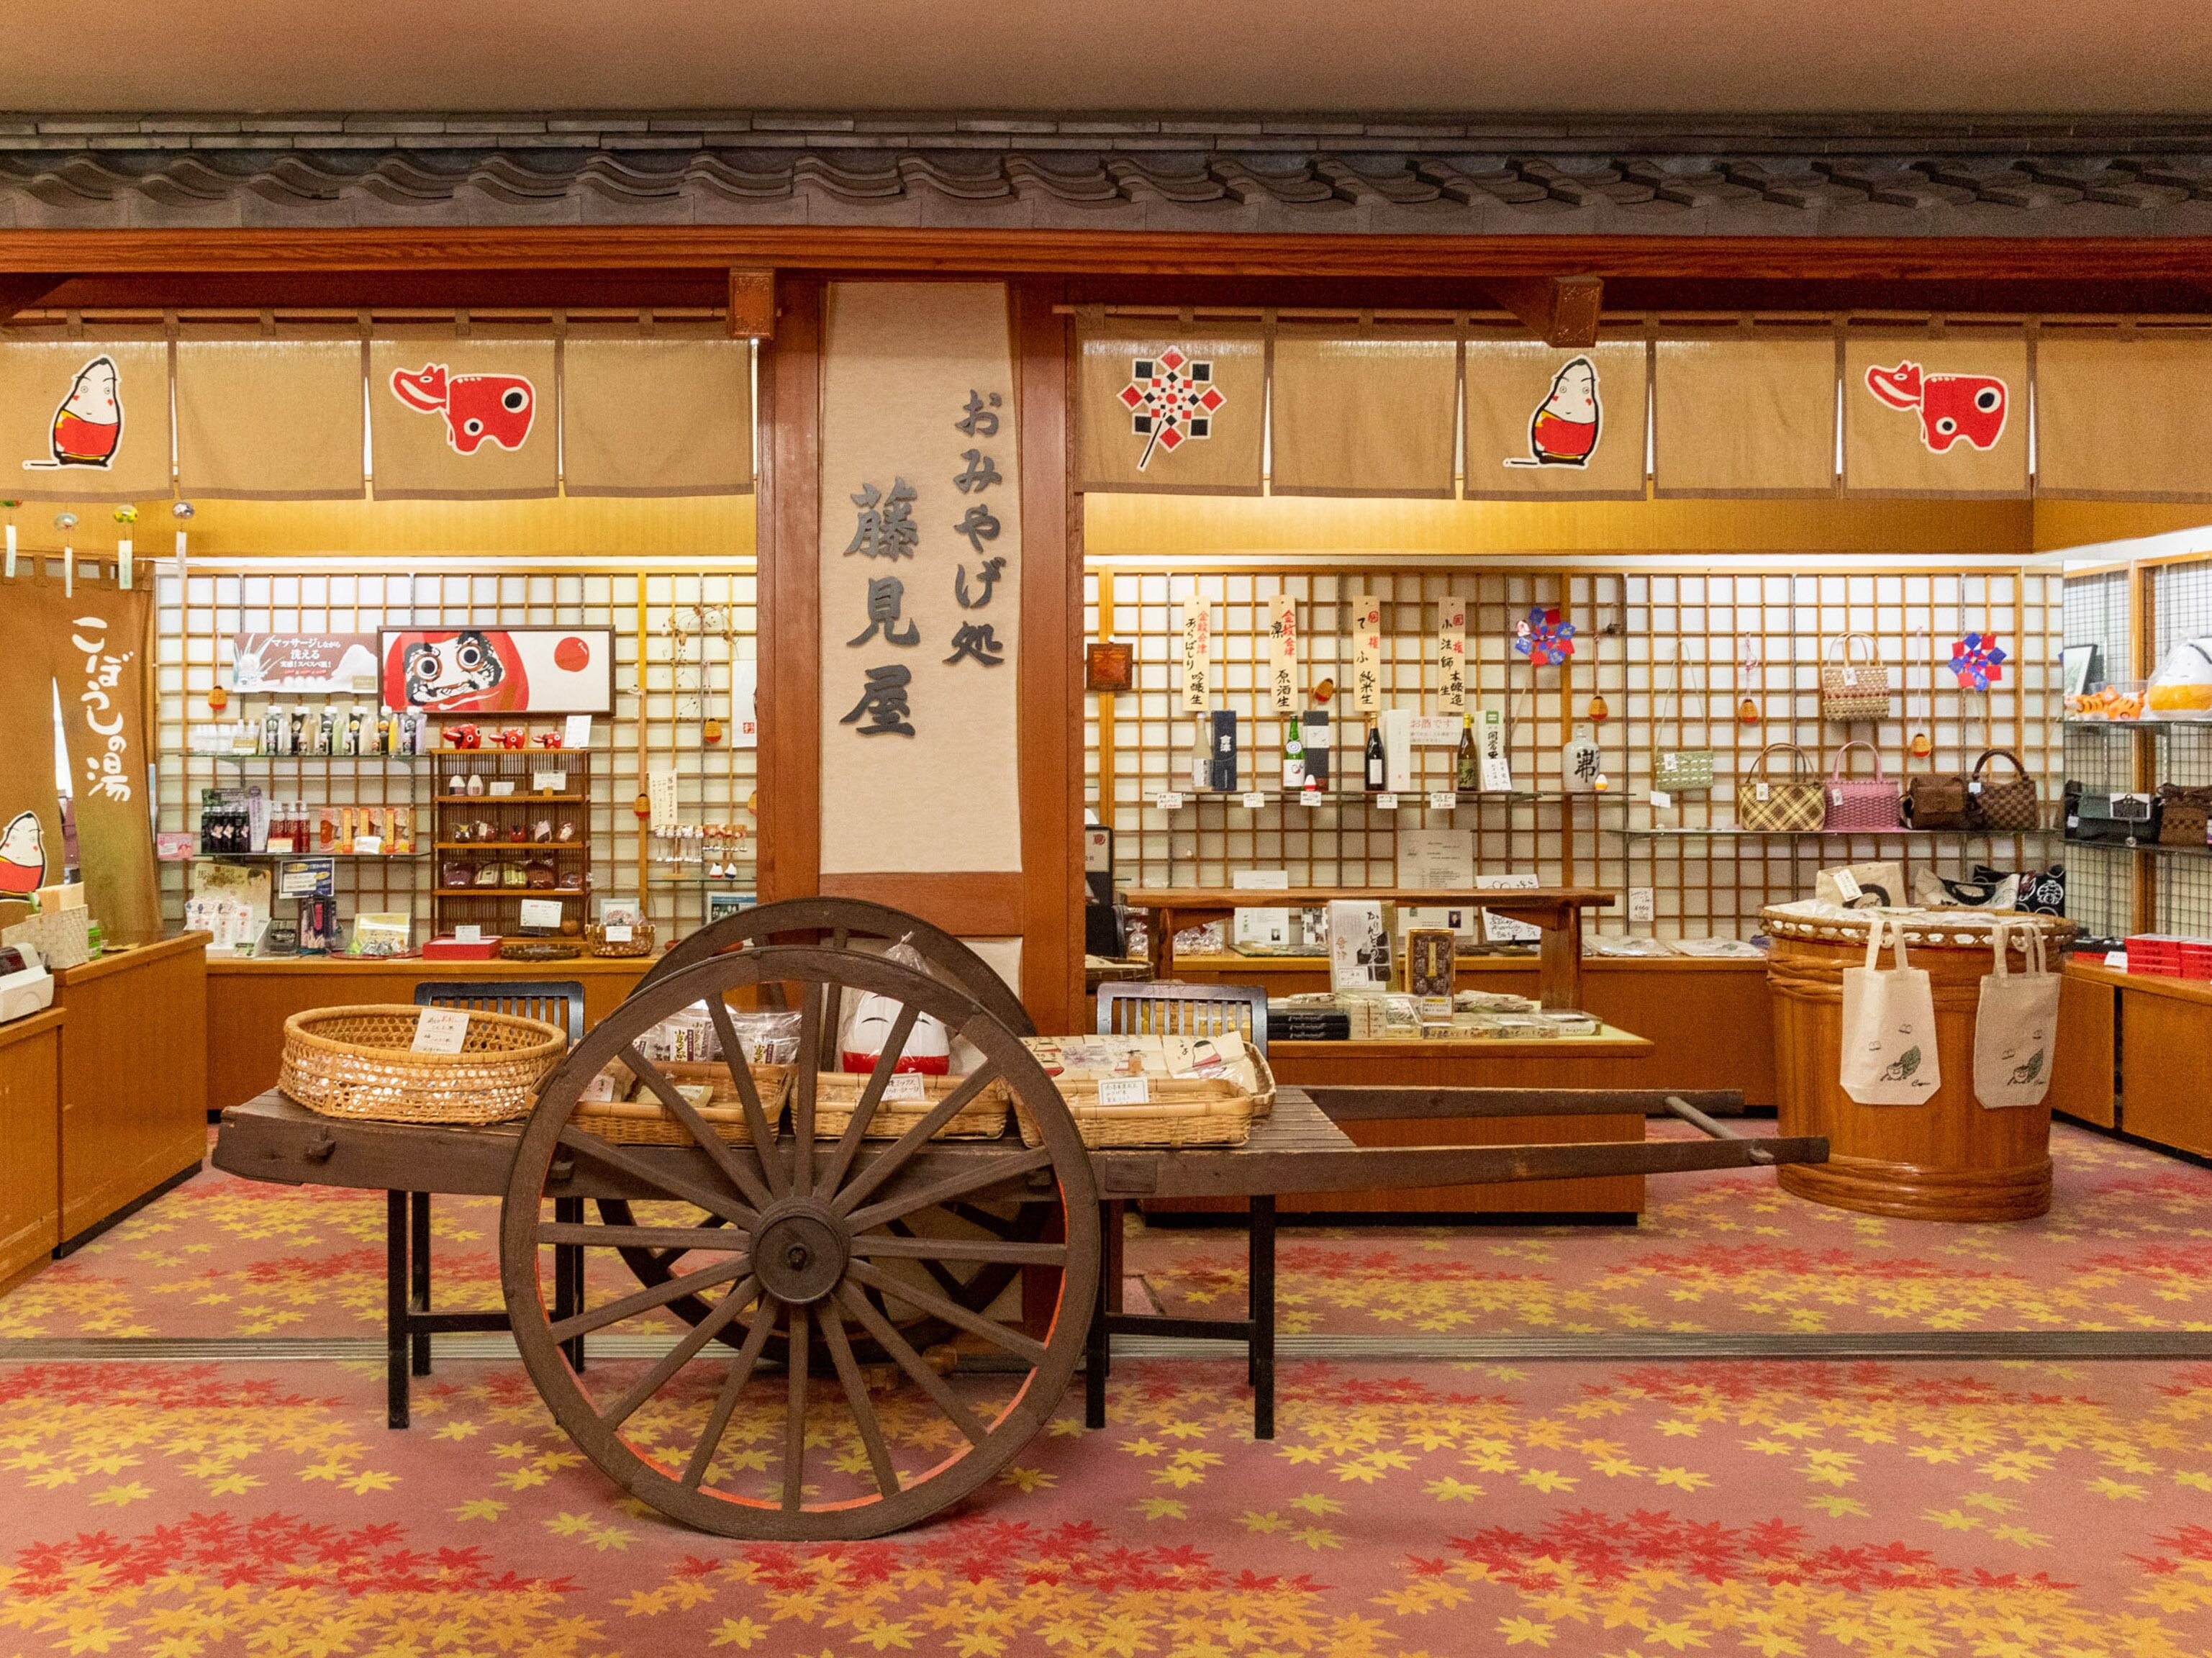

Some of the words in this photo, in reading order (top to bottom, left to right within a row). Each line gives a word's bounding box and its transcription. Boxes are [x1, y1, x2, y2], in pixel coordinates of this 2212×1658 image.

[942, 389, 1007, 666] おみやげ処
[839, 476, 920, 740] 藤見屋
[290, 649, 319, 660] 洗える
[1186, 618, 1196, 671] あらばしり
[1441, 619, 1453, 669] 小法師
[72, 617, 135, 802] こぼうしの湯
[1190, 671, 1205, 705] 吟醸生
[1276, 669, 1291, 707] 原酒生
[1359, 671, 1375, 705] 純米生
[1410, 718, 1452, 729] お酒です
